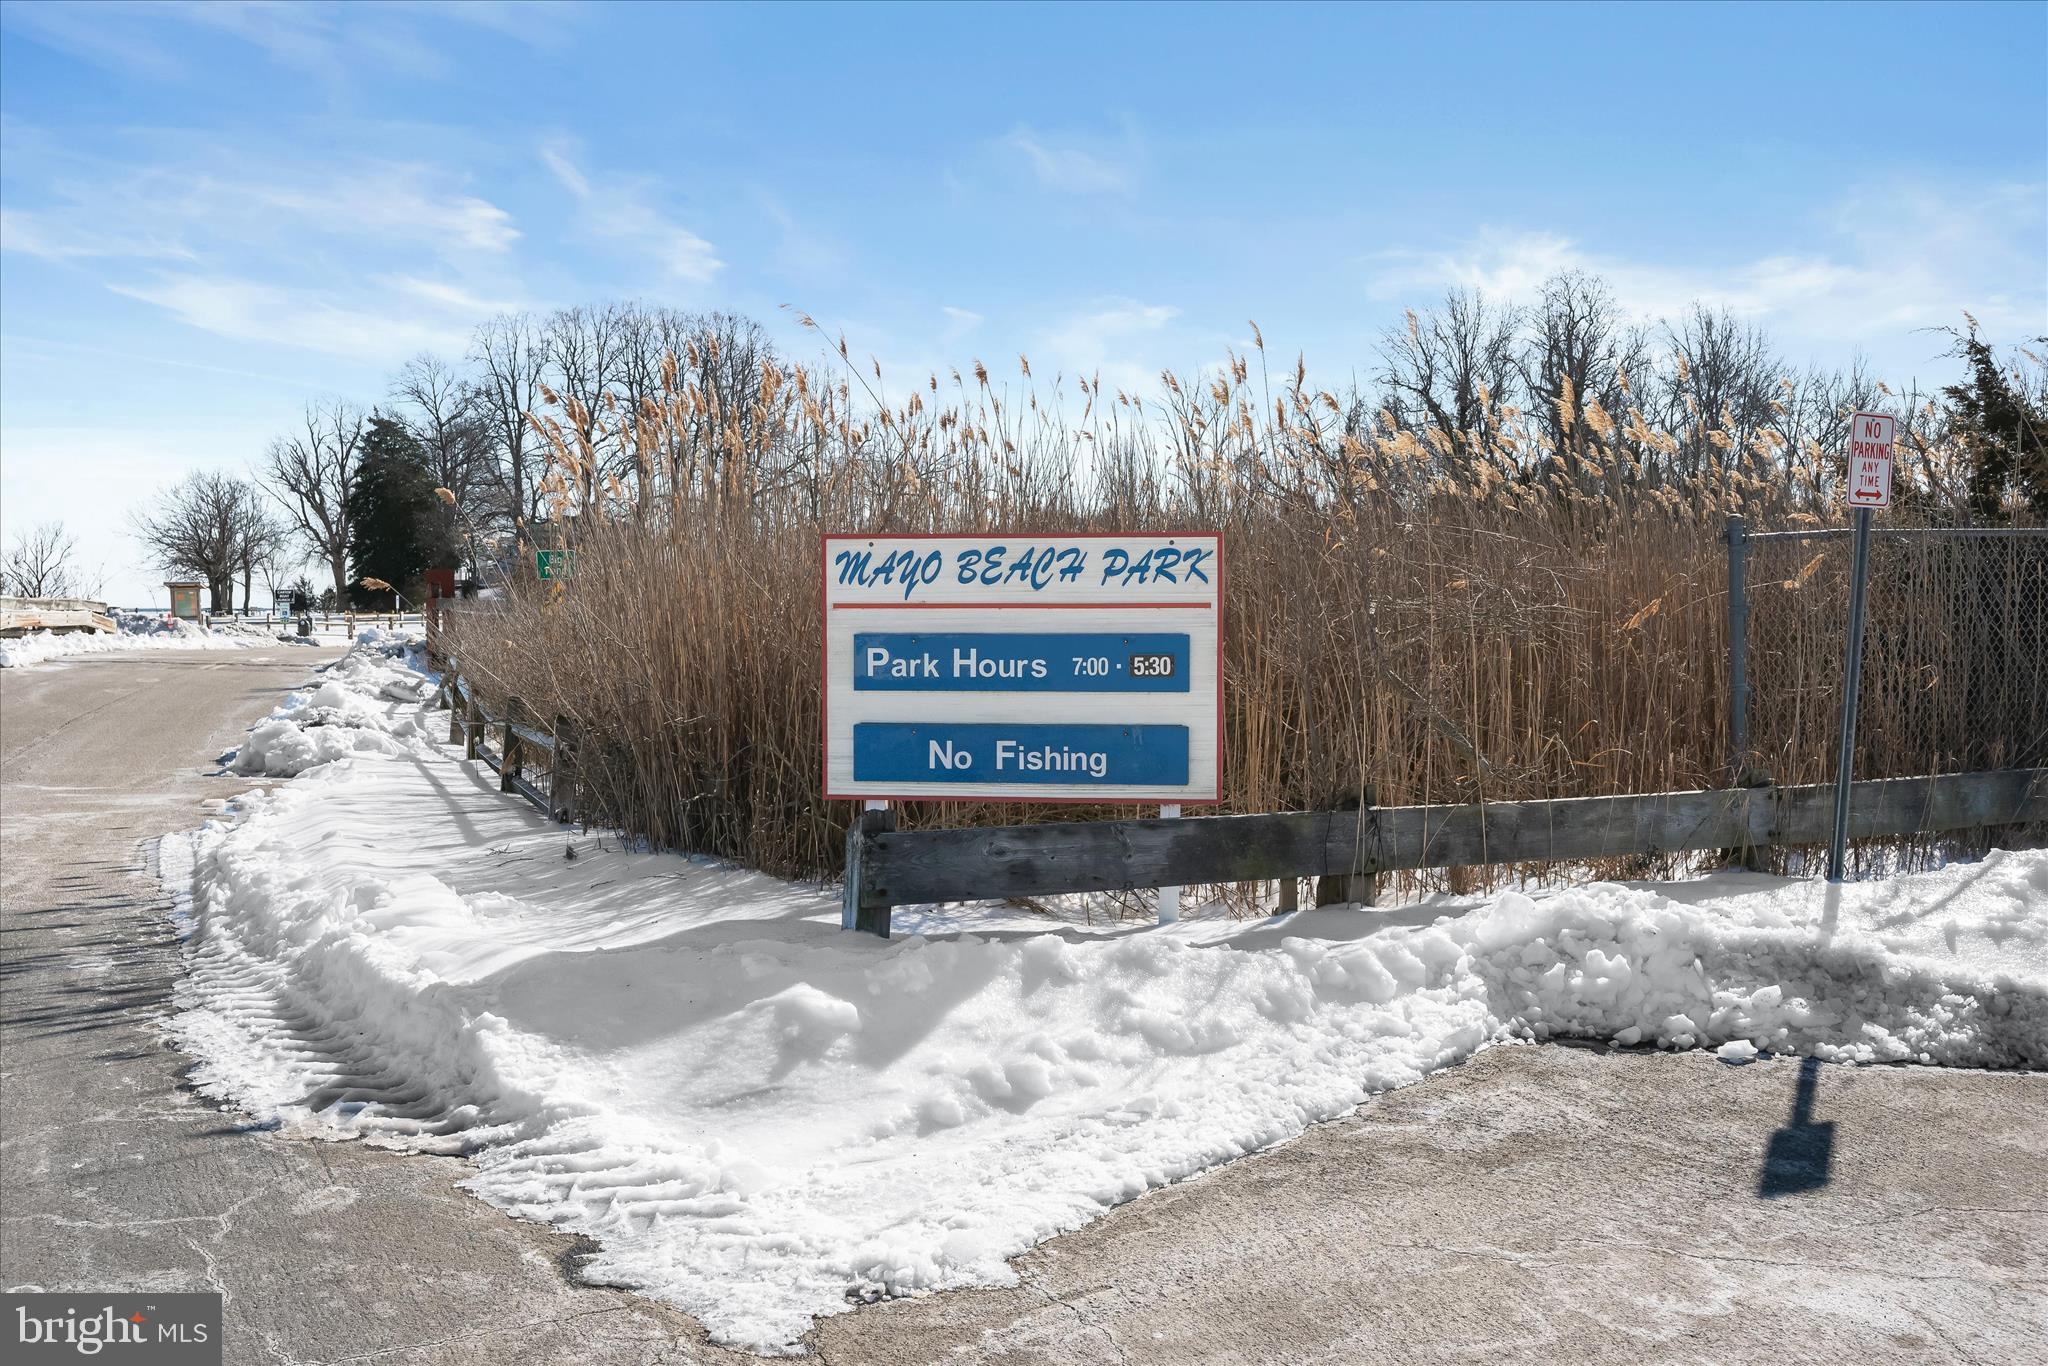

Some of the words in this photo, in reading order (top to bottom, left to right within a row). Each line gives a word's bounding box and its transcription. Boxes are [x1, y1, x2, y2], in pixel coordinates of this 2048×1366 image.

[1865, 421, 1881, 438] NO
[1853, 441, 1890, 460] PARKING
[1862, 461, 1880, 473] ANY
[1860, 475, 1880, 487] TIME
[835, 550, 942, 600] MAYO
[957, 546, 1088, 591] BEACH
[1101, 548, 1214, 586] PARK
[866, 647, 940, 678] Park
[952, 648, 1048, 678] Hours
[1072, 657, 1109, 676] 7:00
[1134, 656, 1171, 676] 5:30
[929, 740, 972, 770] No
[996, 740, 1107, 778] Fishing
